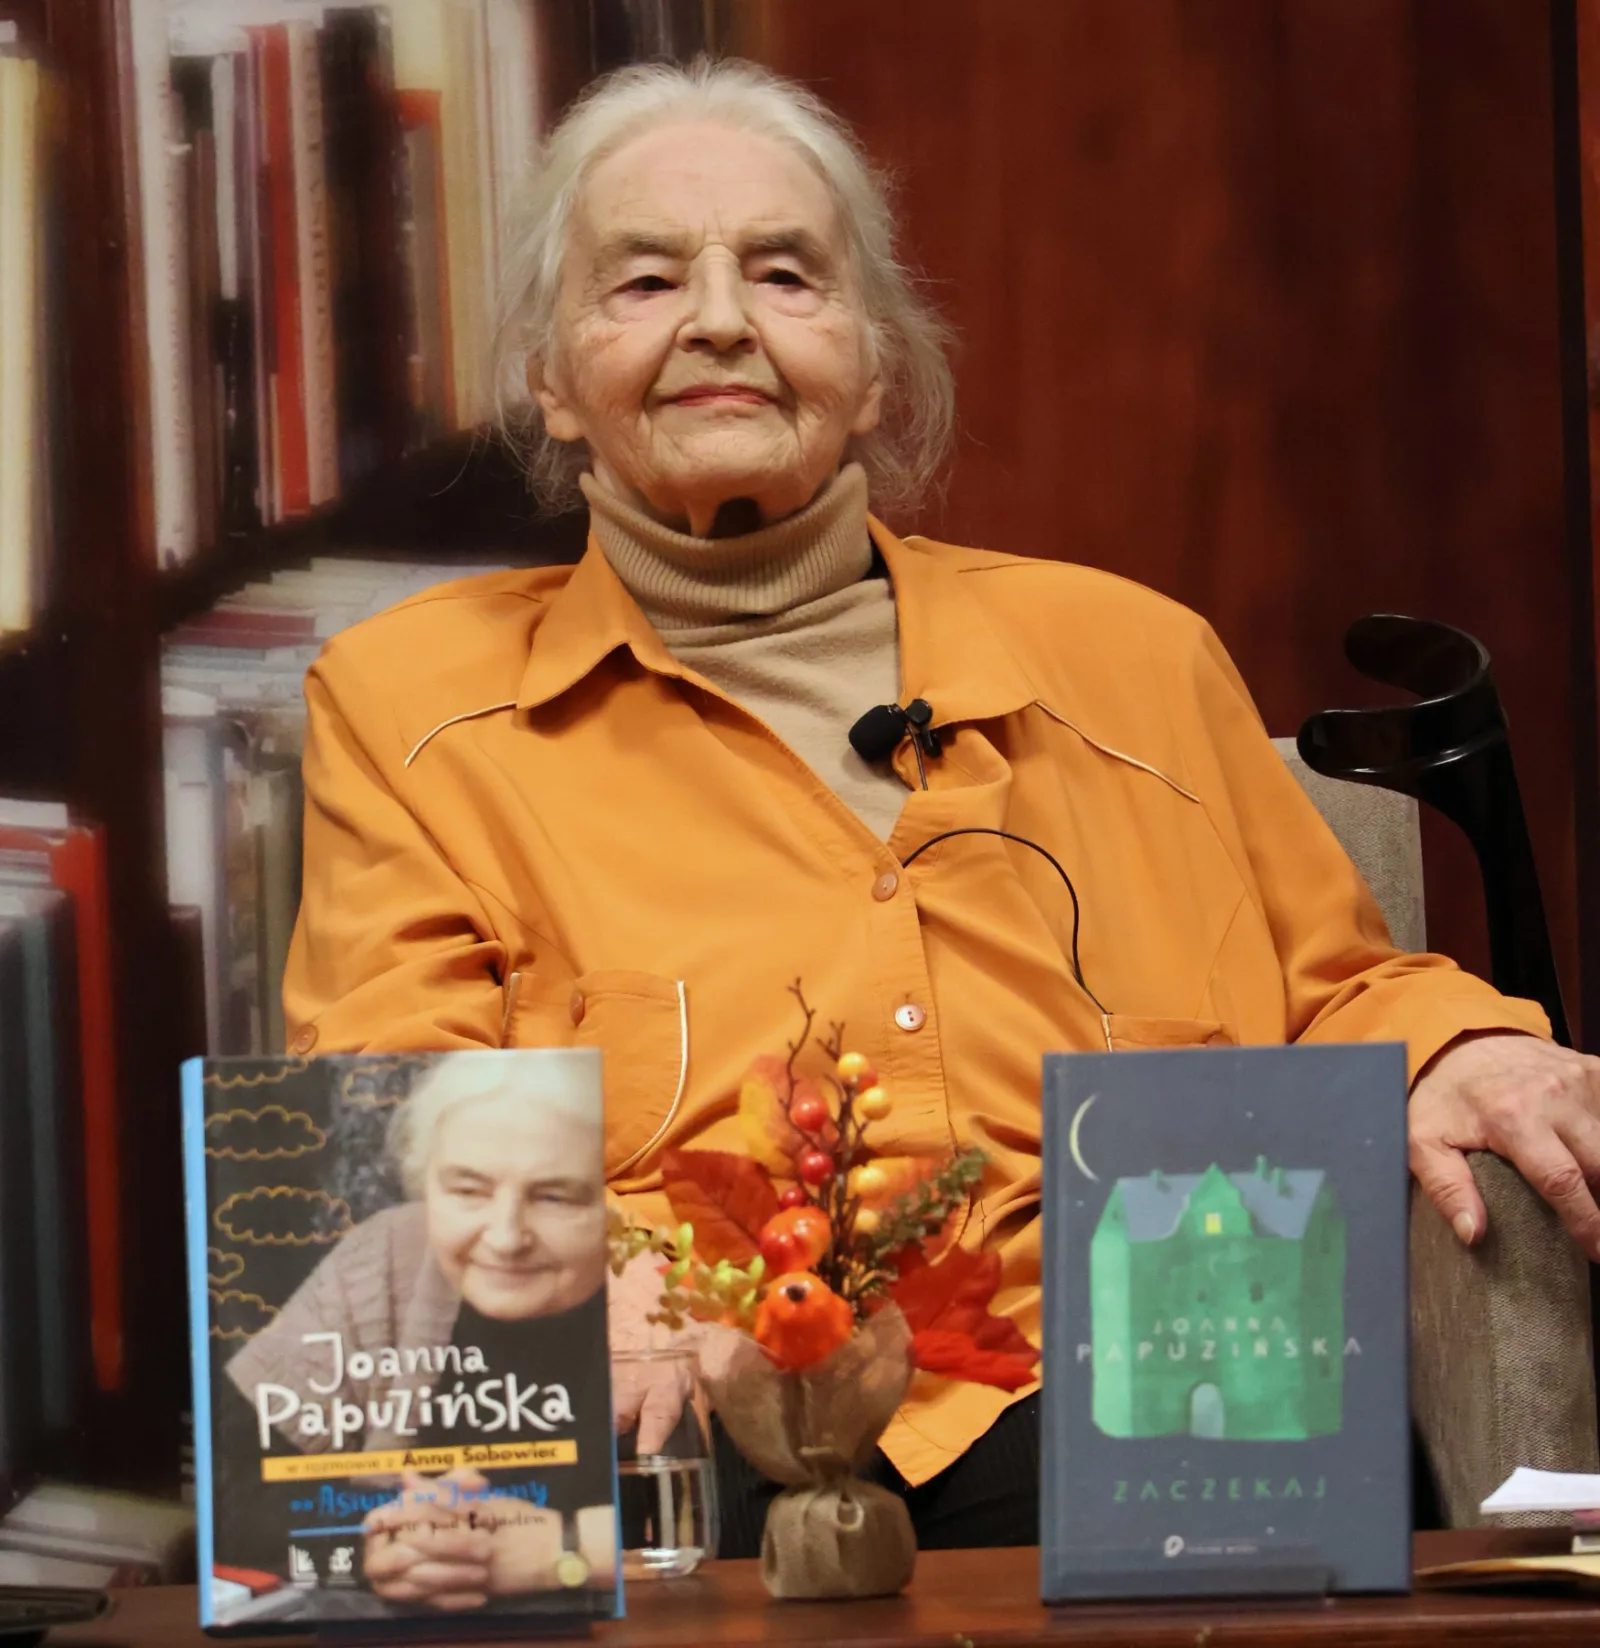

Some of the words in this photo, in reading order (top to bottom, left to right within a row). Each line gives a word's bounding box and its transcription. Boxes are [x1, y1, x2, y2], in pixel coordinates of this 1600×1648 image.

[1152, 1316, 1286, 1335] JOANNA
[302, 1331, 489, 1394] Joanna
[255, 1373, 576, 1449] Papuzińska
[1113, 1475, 1327, 1504] ZACZEKAJ
